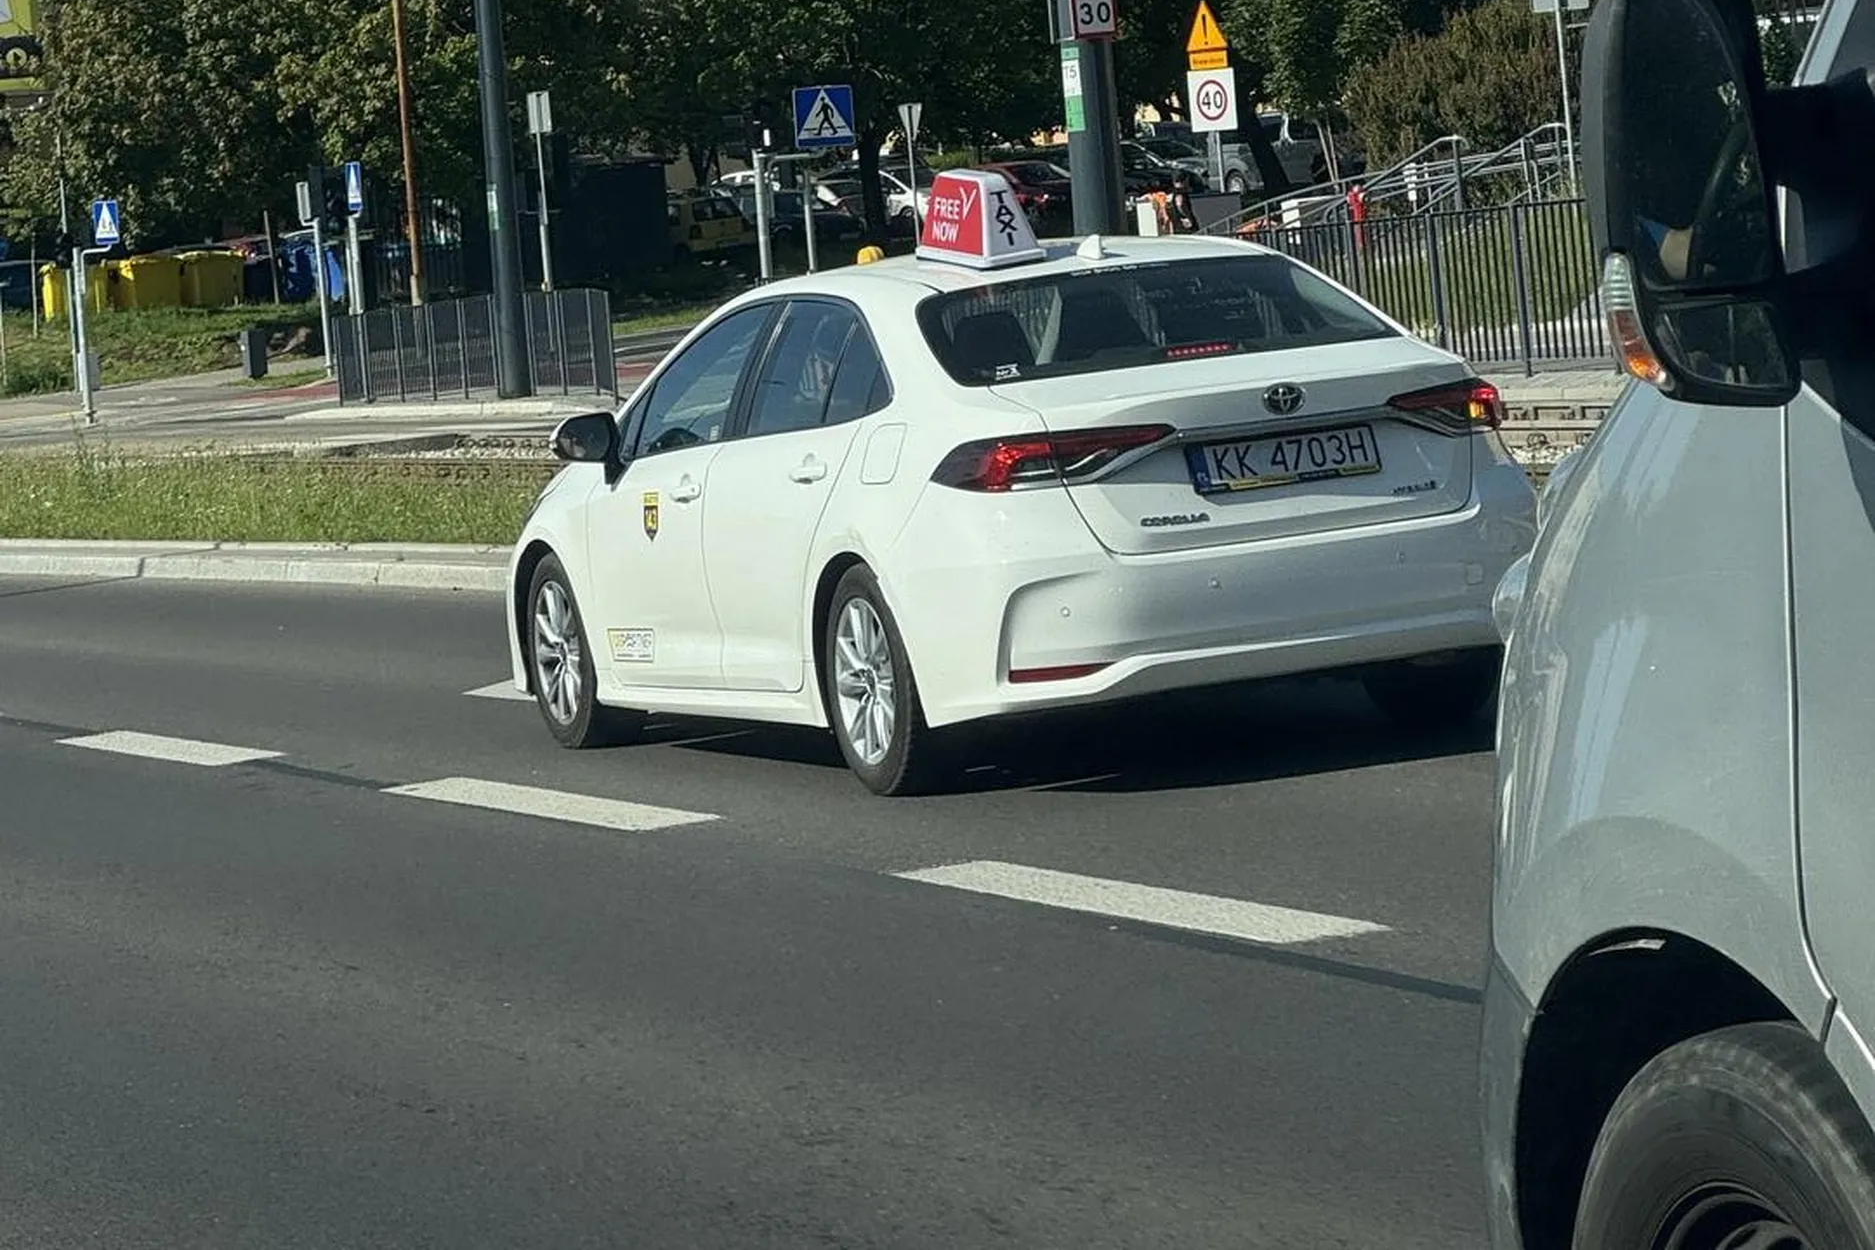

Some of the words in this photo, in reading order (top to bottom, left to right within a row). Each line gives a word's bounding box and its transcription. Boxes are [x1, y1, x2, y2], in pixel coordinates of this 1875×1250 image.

[1079, 1, 1111, 25] 30
[1201, 90, 1223, 110] 40
[933, 196, 961, 220] FREE
[990, 189, 1018, 246] TAXI
[931, 220, 959, 244] NOW
[1212, 445, 1259, 480] KK
[1270, 430, 1369, 472] 4703H
